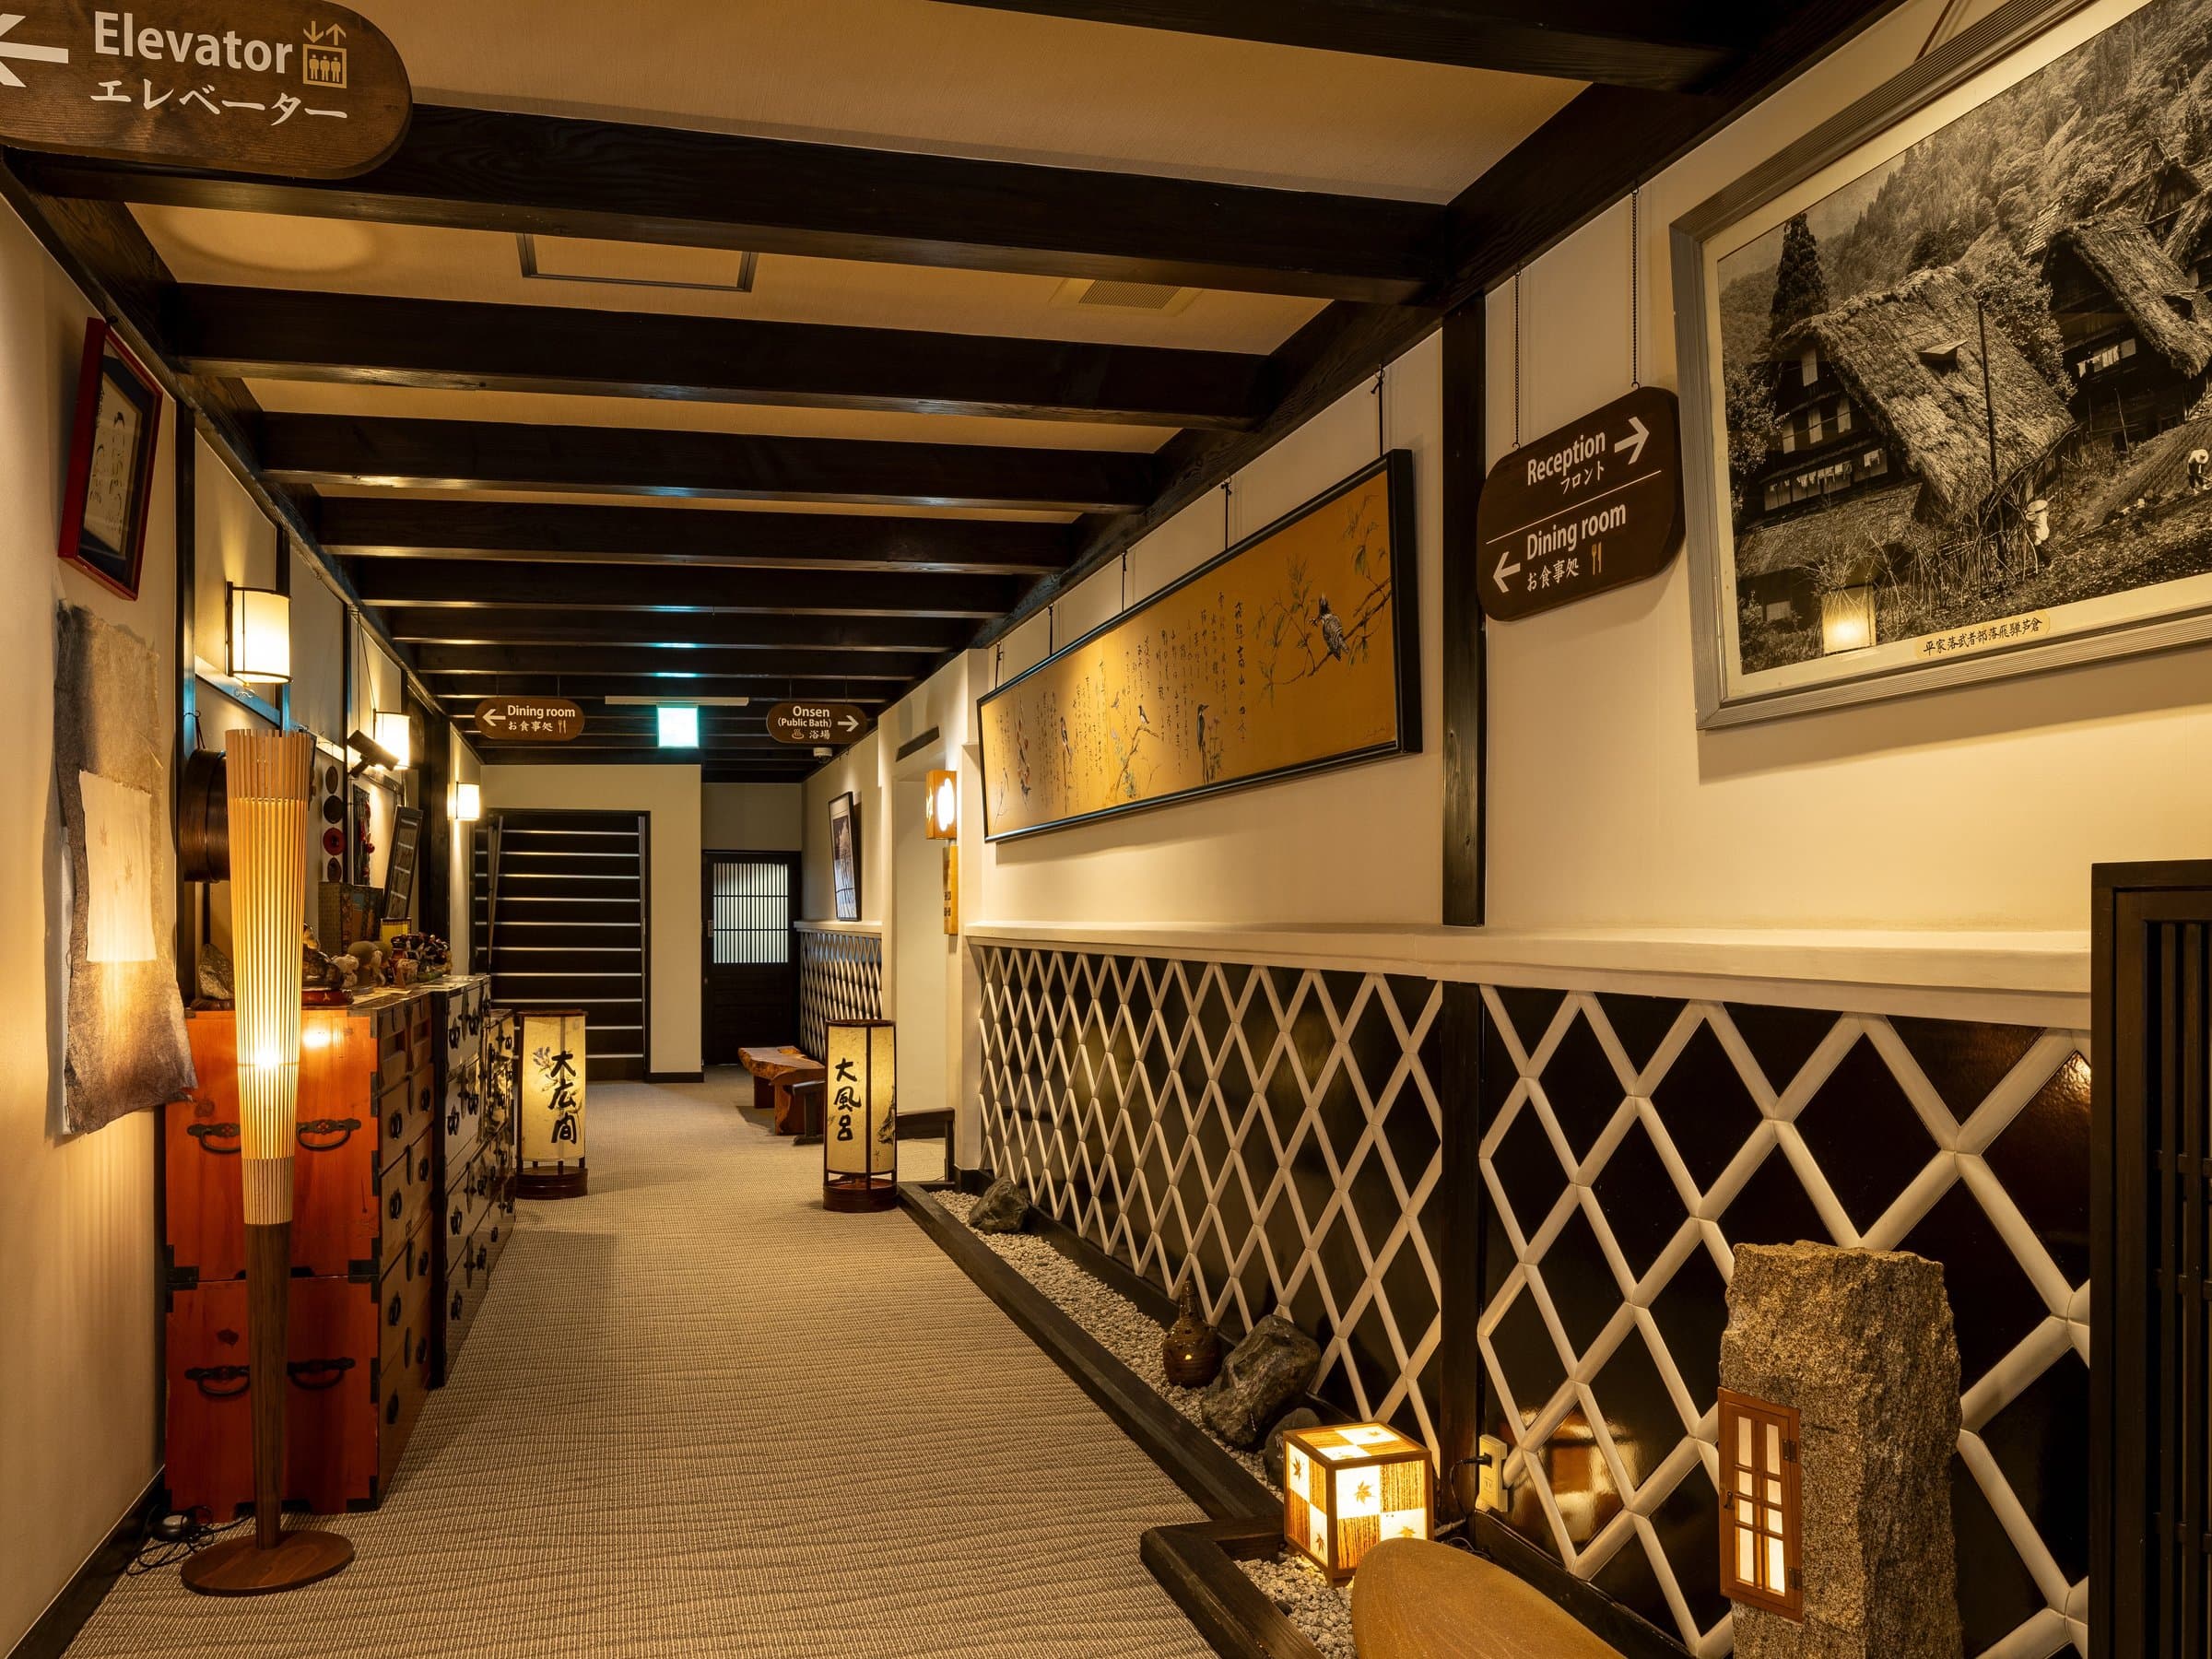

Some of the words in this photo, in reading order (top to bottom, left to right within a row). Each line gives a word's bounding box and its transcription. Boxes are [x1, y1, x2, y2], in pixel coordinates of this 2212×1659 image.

[95, 11, 294, 74] Elevator
[90, 78, 348, 126] エレベーター
[1527, 431, 1606, 487] Reception
[1560, 461, 1606, 495] フロント
[1526, 523, 1578, 560] Dining
[1581, 504, 1627, 540] room
[1526, 558, 1580, 593] お食事処
[507, 704, 544, 719] Dining
[546, 708, 576, 718] room
[508, 720, 553, 732] お食事処
[777, 717, 807, 727] (Public
[808, 718, 832, 728] Bath)
[793, 705, 830, 717] Onsen
[809, 729, 830, 740] 浴場
[548, 1051, 577, 1145] 大広間
[833, 1057, 862, 1142] 大風呂
